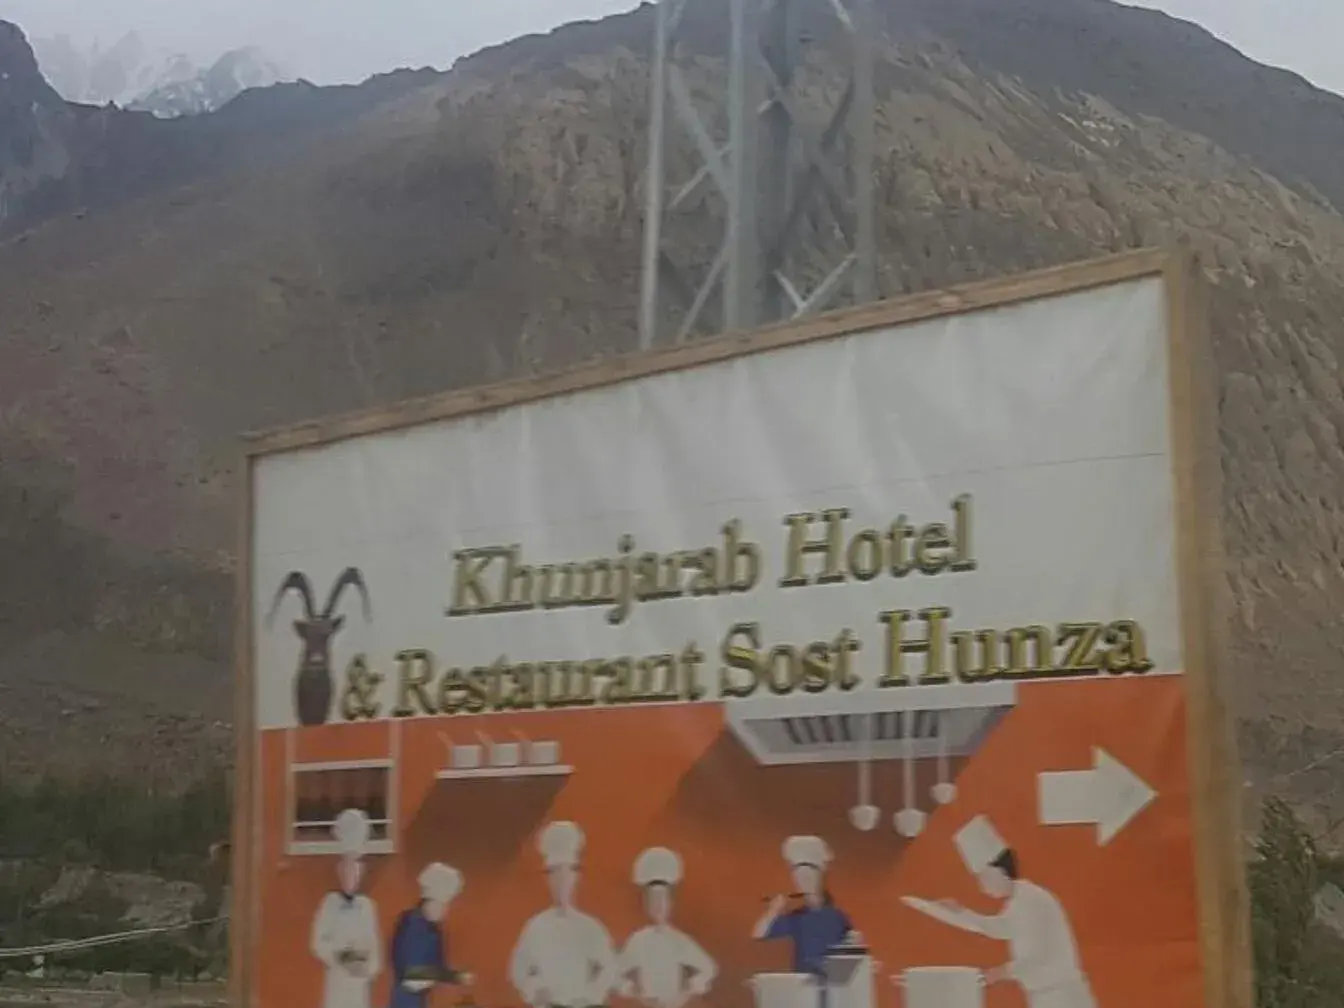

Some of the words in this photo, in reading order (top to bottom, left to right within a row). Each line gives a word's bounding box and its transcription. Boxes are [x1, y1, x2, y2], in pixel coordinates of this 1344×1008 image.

[446, 518, 761, 624] Khunjarab
[778, 493, 977, 588] Hotel
[340, 652, 385, 721] &
[390, 640, 706, 719] Restaurant
[719, 621, 863, 698] Sost
[878, 606, 1155, 687] Hunza
